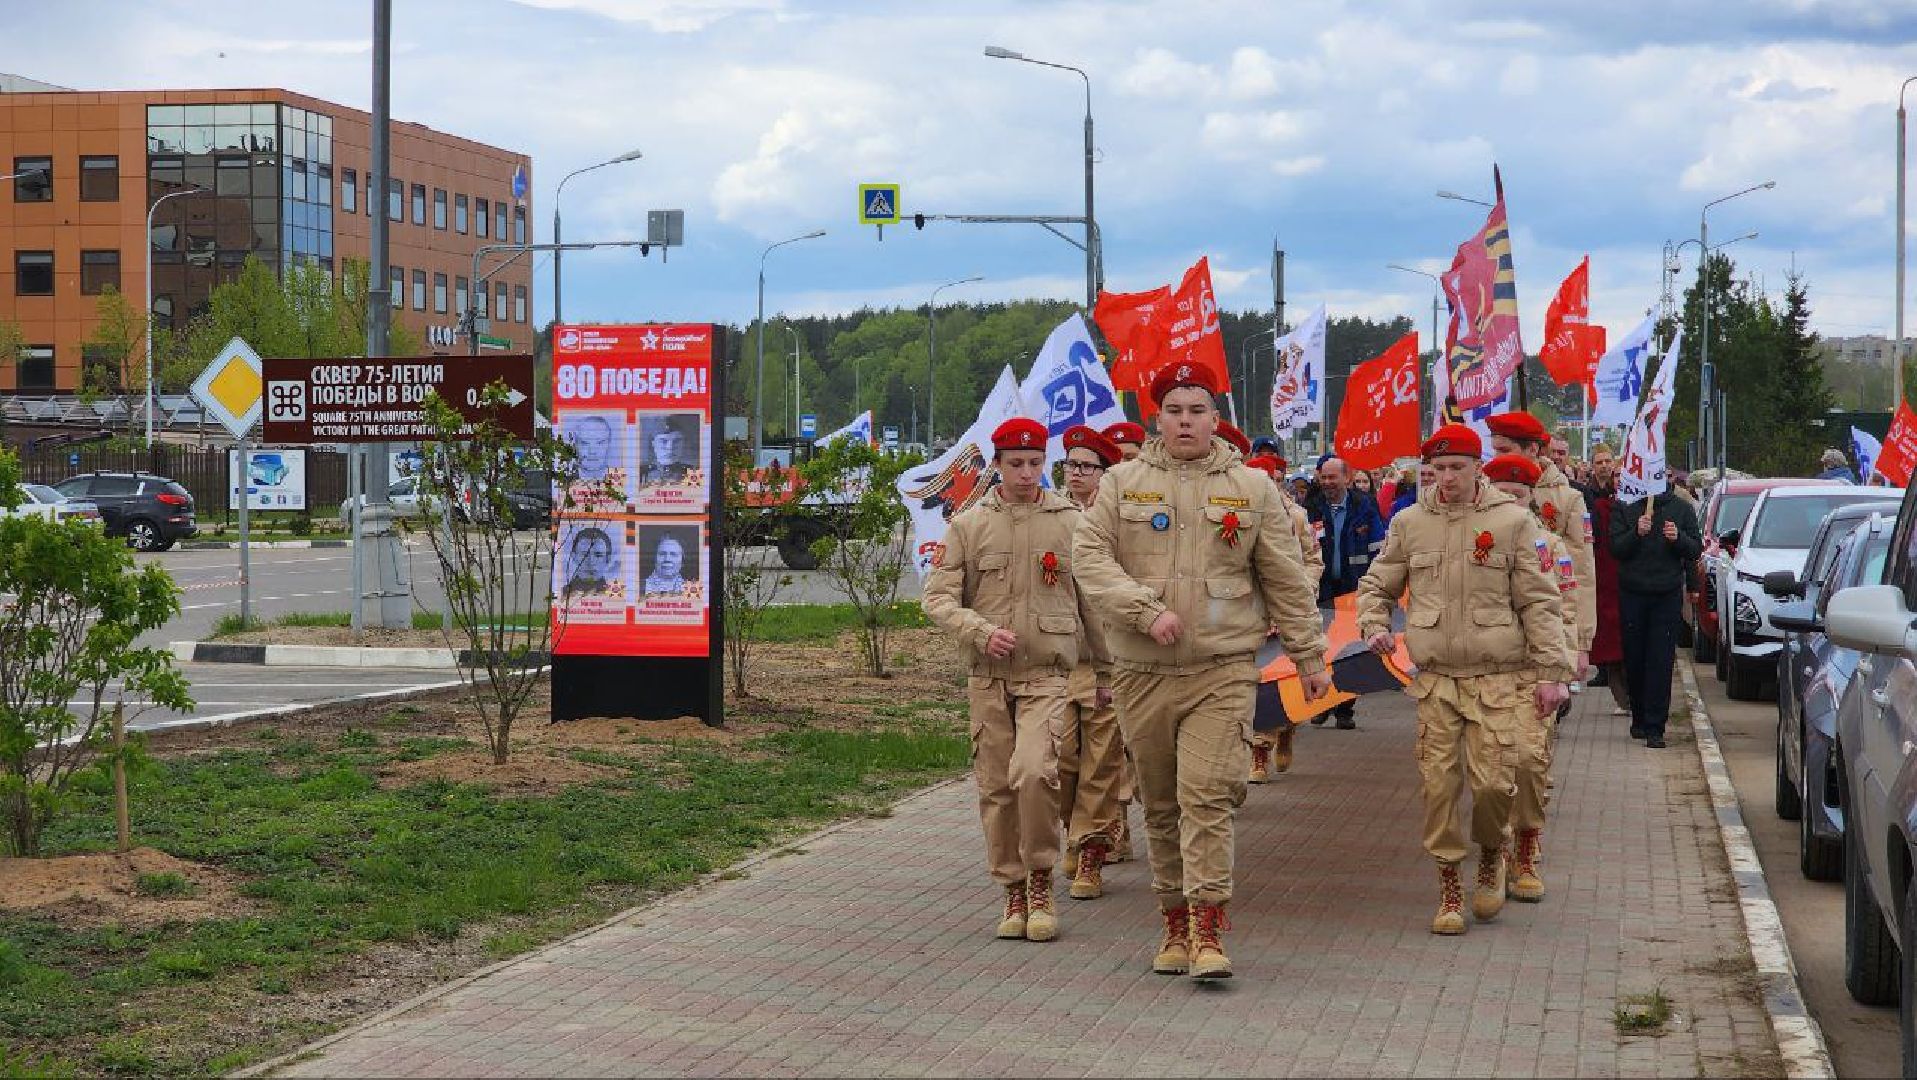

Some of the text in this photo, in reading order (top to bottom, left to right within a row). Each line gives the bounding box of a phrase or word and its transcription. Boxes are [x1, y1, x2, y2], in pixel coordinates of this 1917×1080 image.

[311, 364, 444, 385] СКВЕР 75-ЛЕТИЯ
[557, 364, 707, 399] 80 ПОБЕДА!
[312, 385, 382, 407] ПОБЕДЫ
[386, 385, 399, 403] В
[312, 410, 429, 424] SQUARE 75TH ANNIVERSA
[312, 425, 349, 436] VICTORY
[350, 425, 361, 436] IN
[362, 424, 381, 436] THE
[382, 424, 409, 436] GREAT
